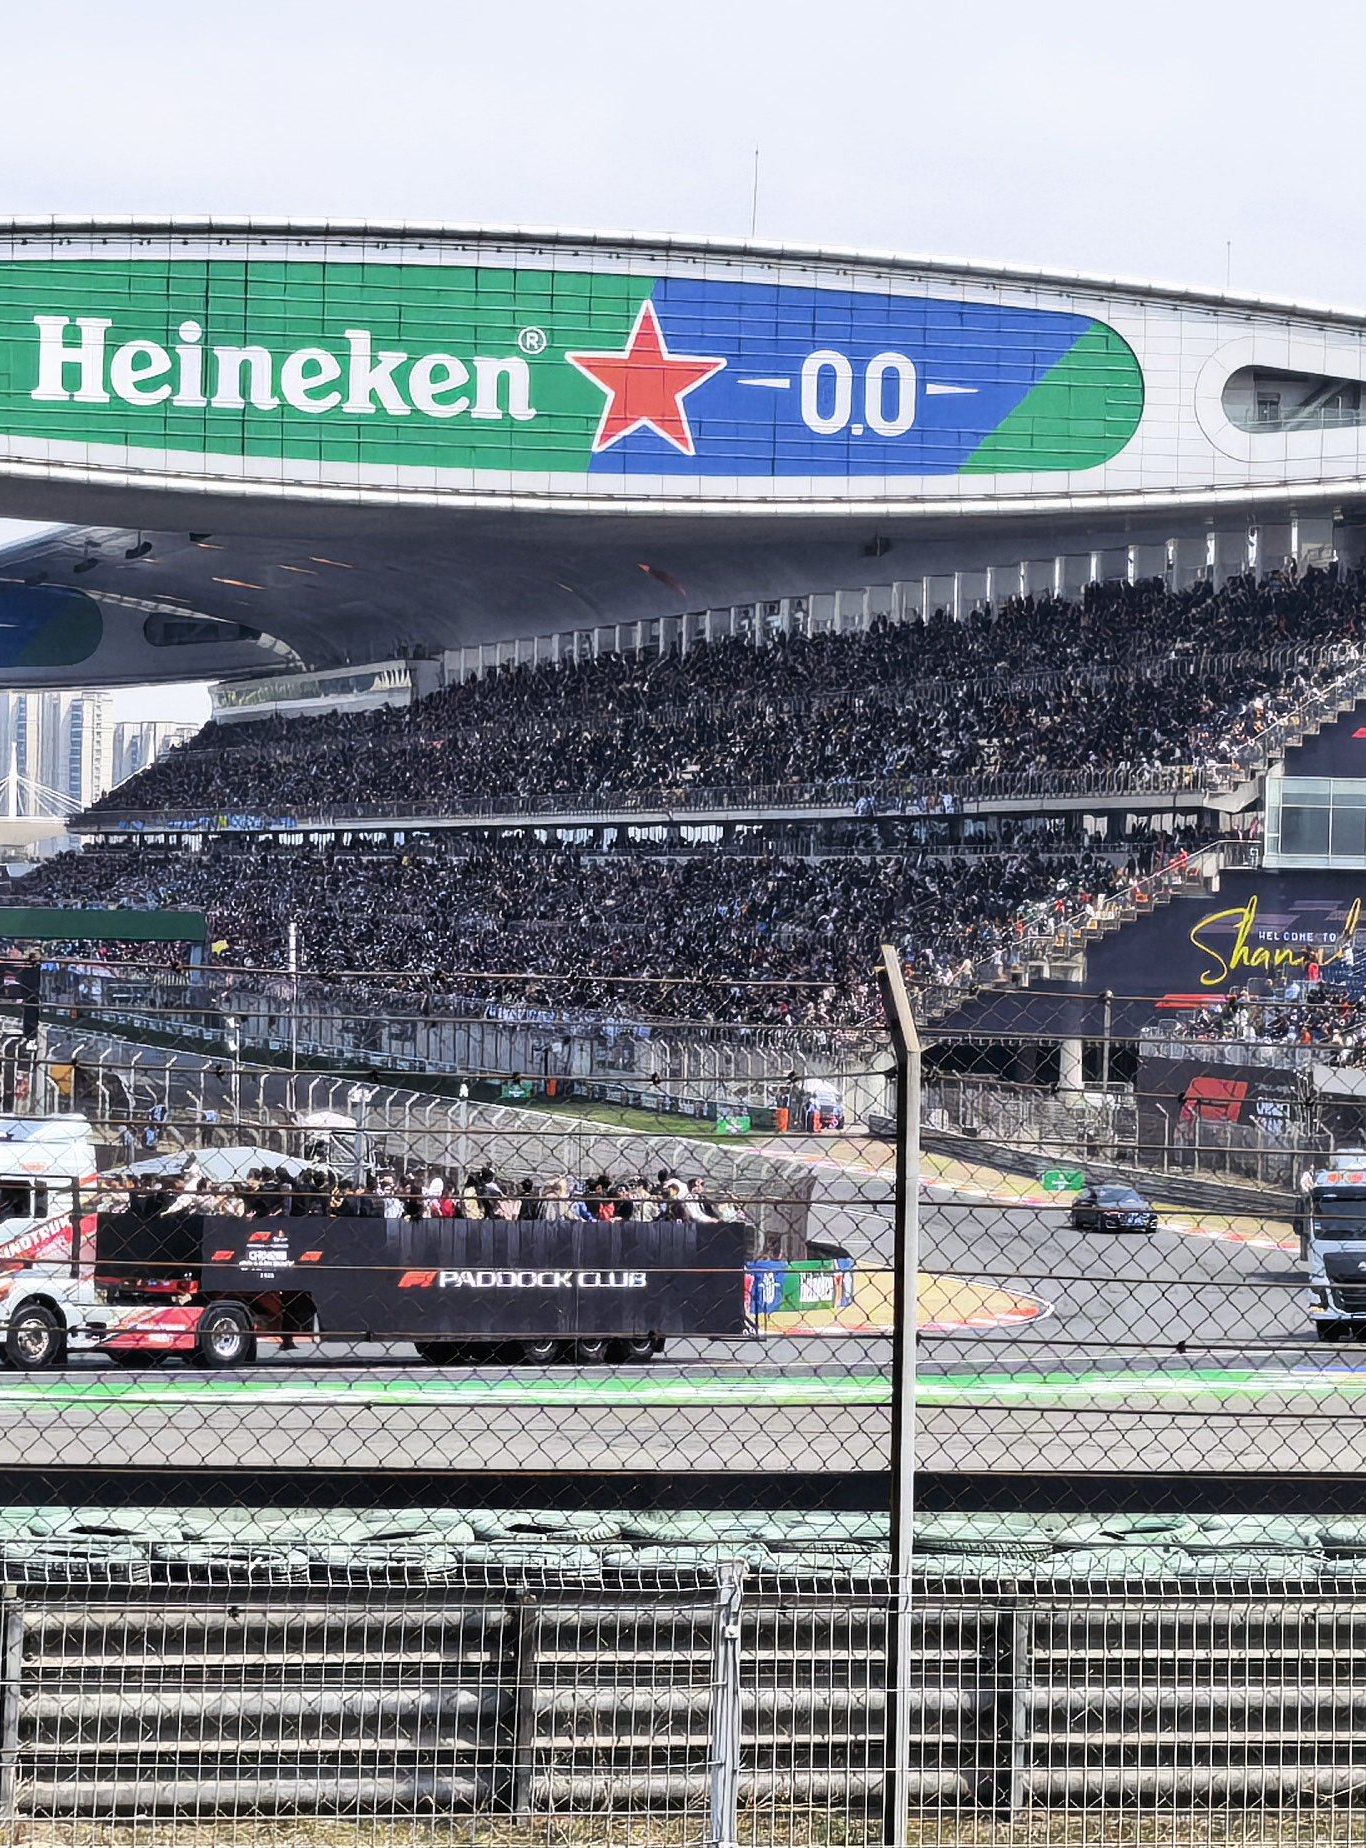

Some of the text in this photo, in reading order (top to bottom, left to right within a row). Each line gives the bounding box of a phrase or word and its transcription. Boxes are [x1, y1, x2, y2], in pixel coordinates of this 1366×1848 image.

[31, 315, 537, 421] Heineken
[801, 349, 916, 437] 0.0
[1323, 931, 1337, 943] TO
[439, 1271, 573, 1288] PADDOCK
[577, 1271, 648, 1288] CLUB
